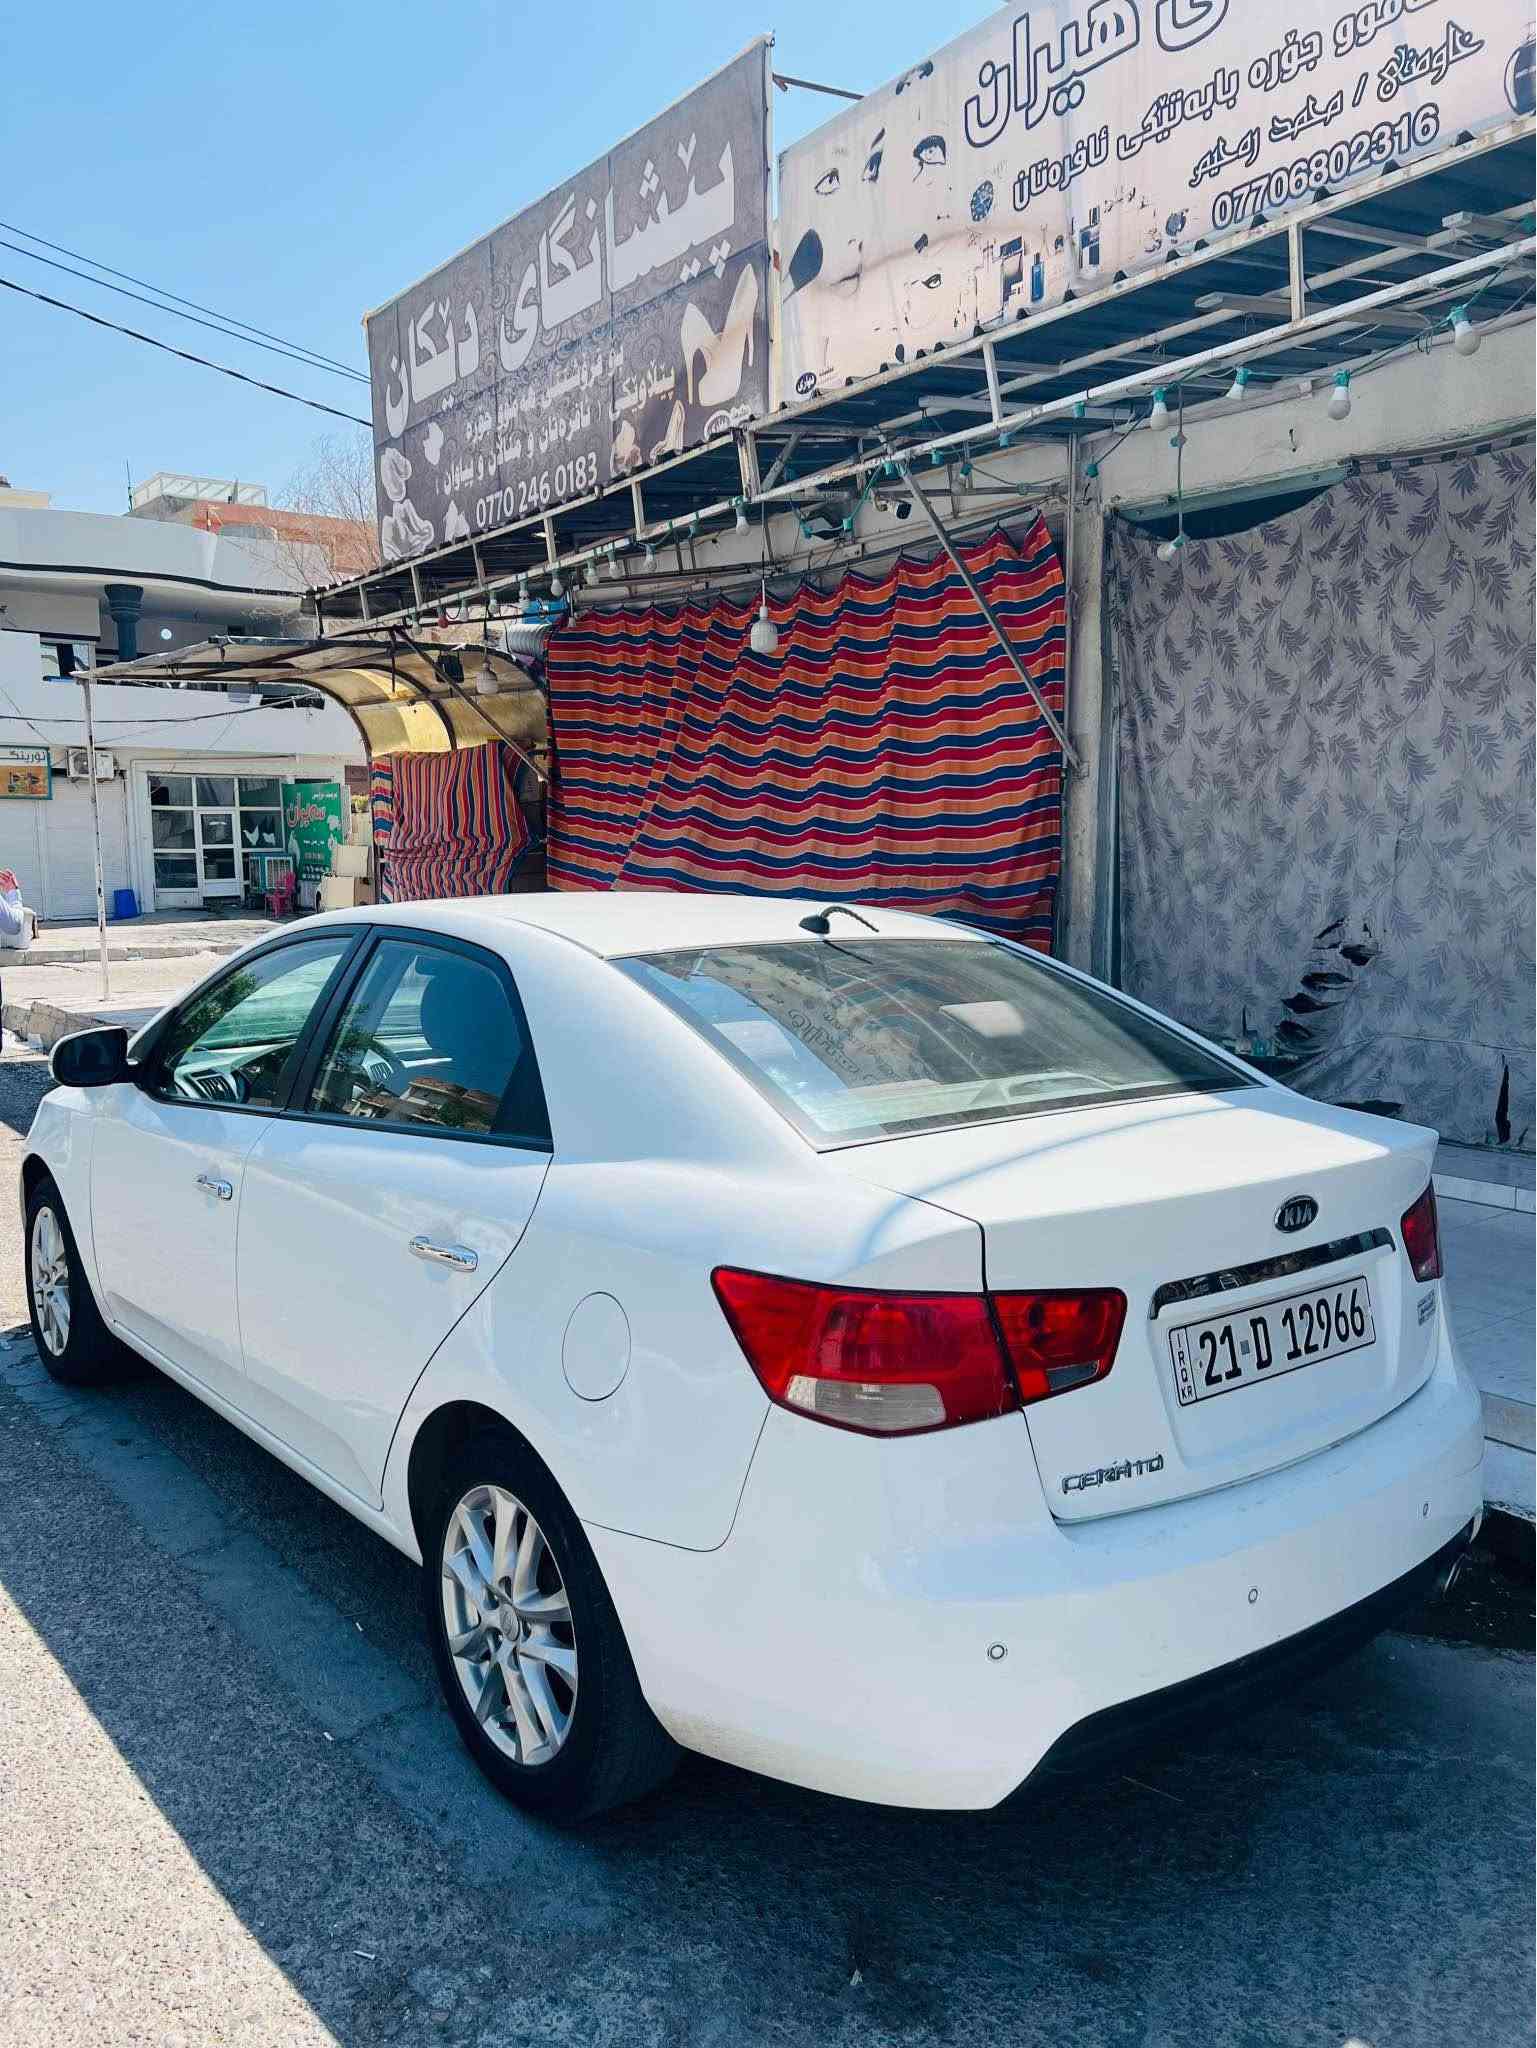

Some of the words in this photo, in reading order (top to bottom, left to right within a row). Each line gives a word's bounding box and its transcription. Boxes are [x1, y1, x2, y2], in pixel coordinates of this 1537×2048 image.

[1249, 30, 1322, 91] جۆرە
[1212, 102, 1440, 230] 07706802316
[475, 486, 515, 529] 0770
[518, 471, 551, 514] 246
[553, 450, 599, 498] 0183
[1280, 1199, 1315, 1229] KIA
[1199, 1325, 1243, 1387] 21
[1250, 1316, 1273, 1371] D
[1281, 1287, 1365, 1361] 12966
[1061, 1453, 1164, 1495] CERATO
